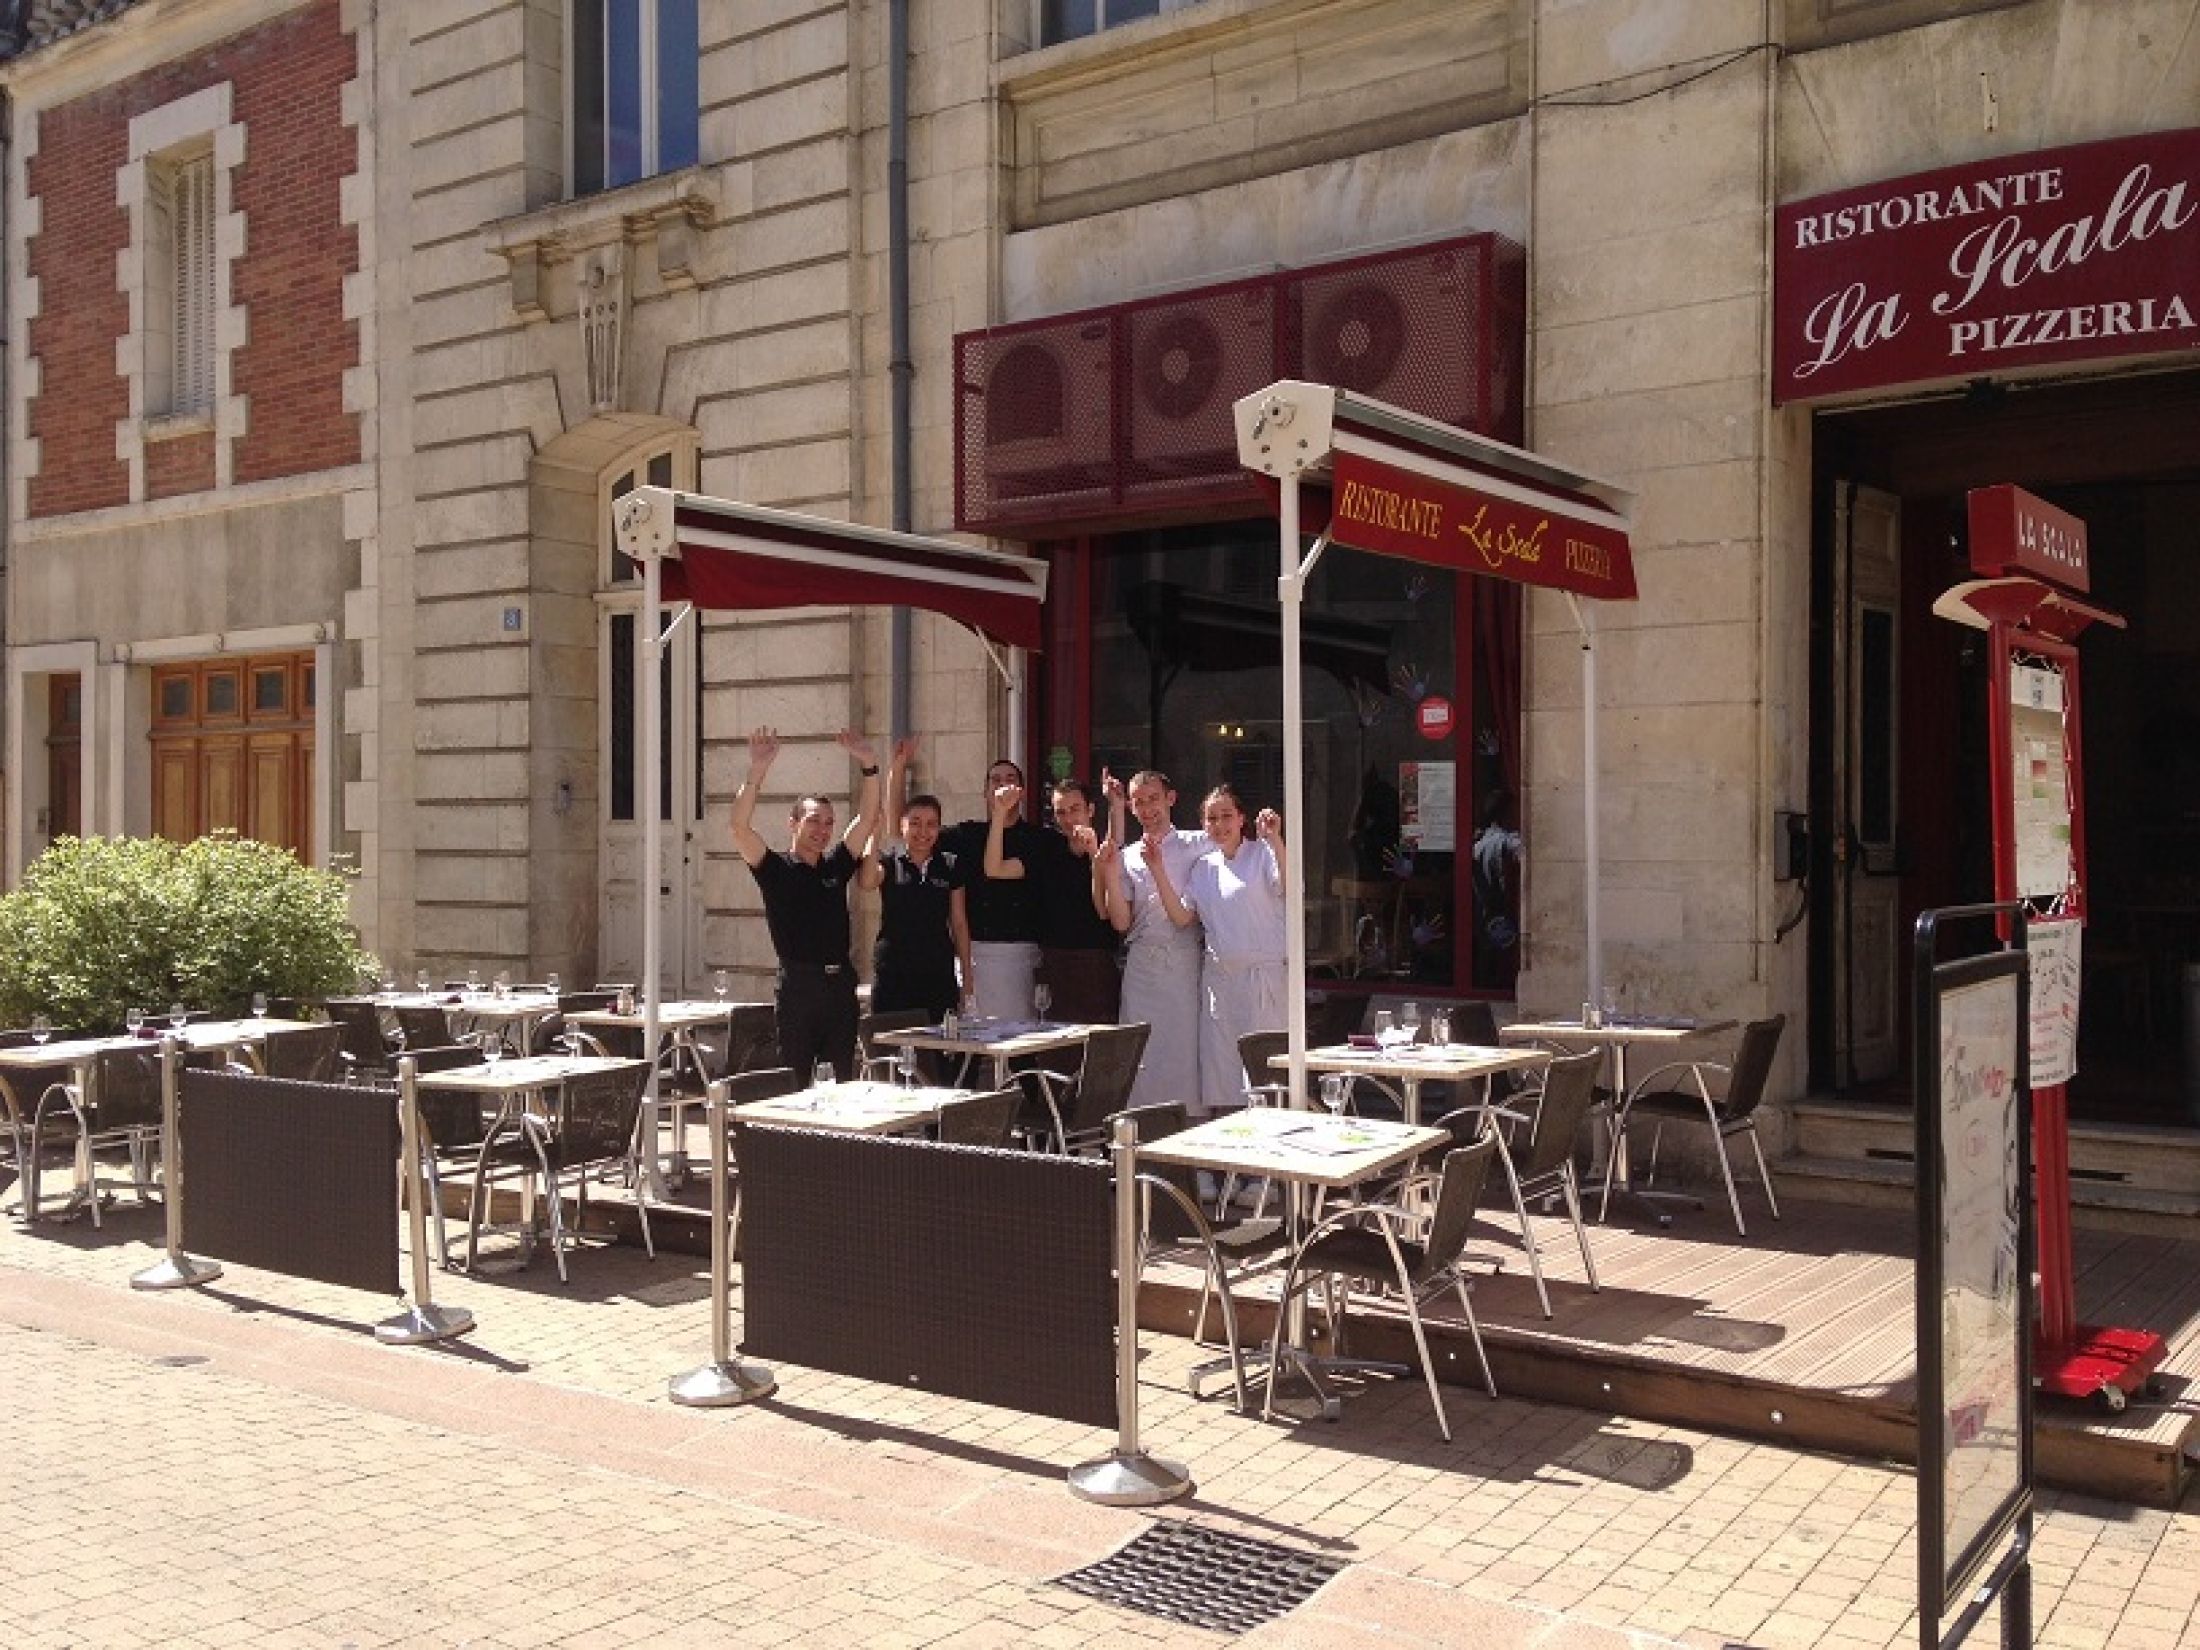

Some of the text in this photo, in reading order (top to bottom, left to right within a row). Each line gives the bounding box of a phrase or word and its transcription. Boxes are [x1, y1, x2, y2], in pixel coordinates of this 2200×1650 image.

[1795, 168, 2064, 249] RISTORANTE
[1793, 163, 2199, 379] La Scala
[1948, 294, 2197, 356] PIZZERIA
[1339, 481, 1443, 540] RISTORANTE
[1458, 504, 1503, 568] La
[2018, 510, 2082, 567] LA SCALA
